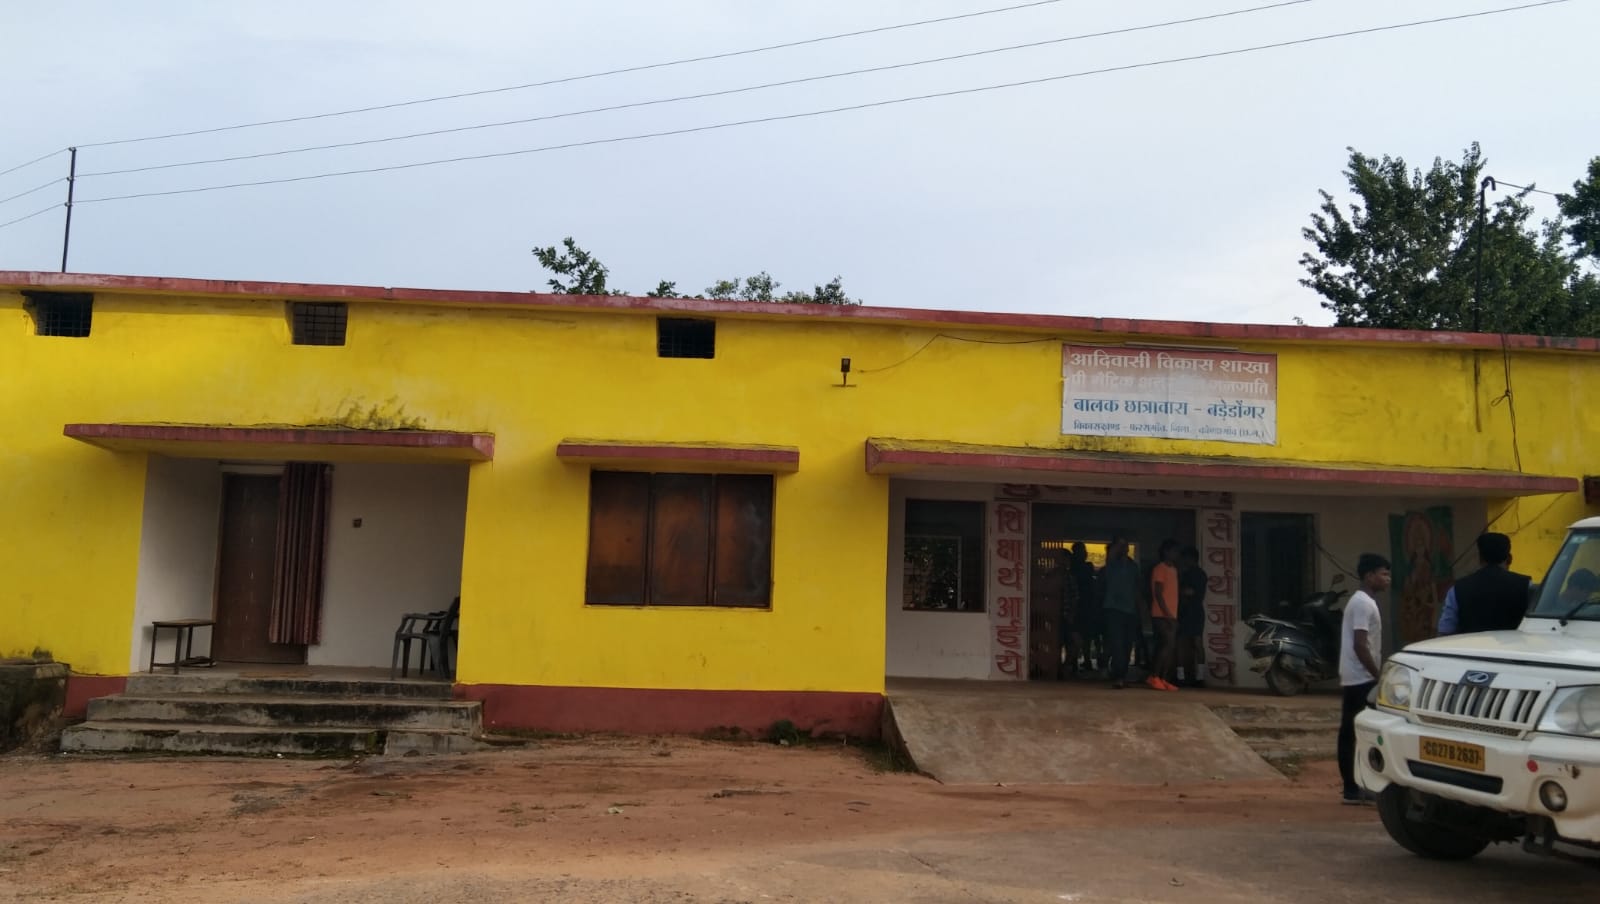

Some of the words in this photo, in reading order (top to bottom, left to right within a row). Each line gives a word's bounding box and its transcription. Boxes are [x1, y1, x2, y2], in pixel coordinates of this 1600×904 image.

[1070, 350, 1150, 370] आदिवासी
[1157, 351, 1214, 372] विकास
[1220, 360, 1270, 375] शाखा
[1073, 398, 1119, 413] बालक
[1124, 400, 1188, 416] छात्रावास
